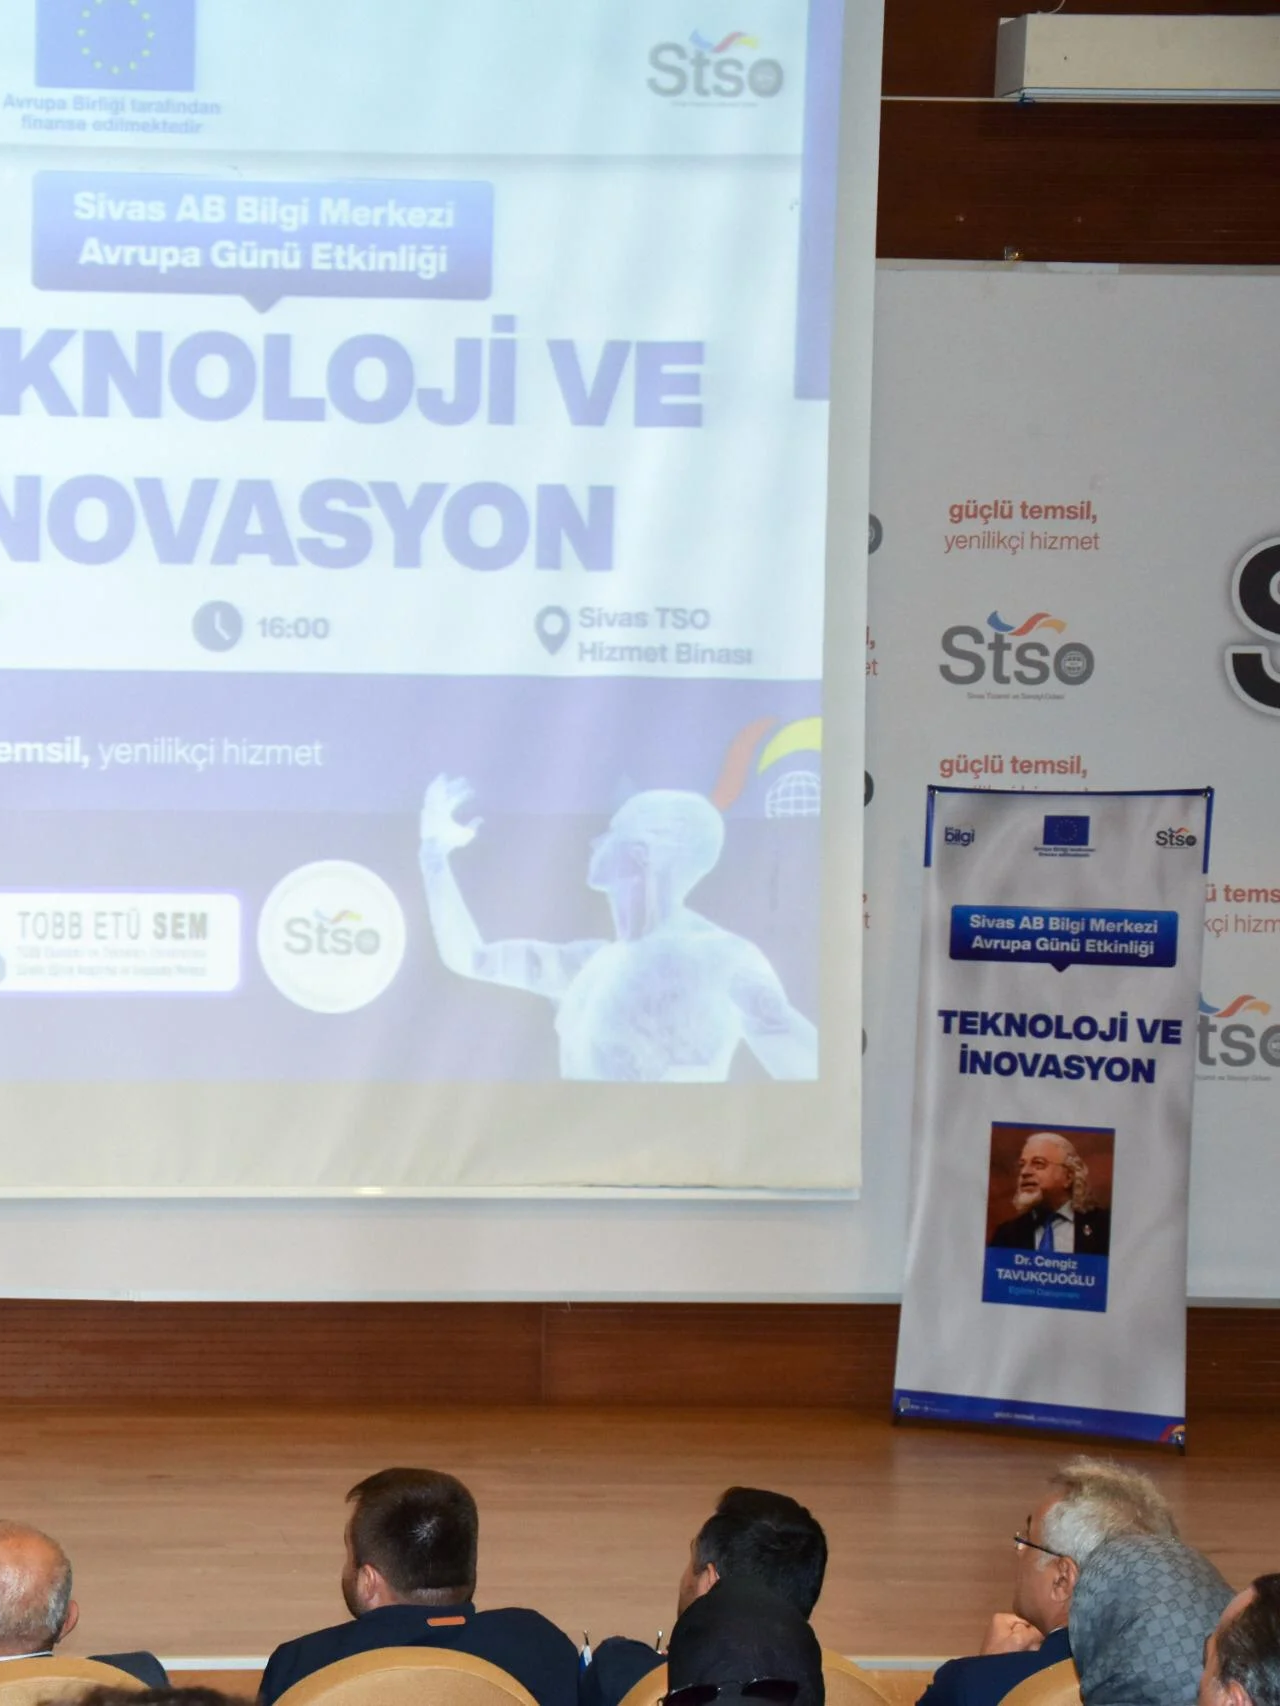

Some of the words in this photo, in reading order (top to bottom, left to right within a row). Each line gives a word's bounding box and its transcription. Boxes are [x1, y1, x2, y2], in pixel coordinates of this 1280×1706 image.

[3, 93, 67, 112] Avrupa
[22, 115, 86, 130] finanse
[92, 117, 203, 133] edilmektedir
[73, 191, 169, 226] Sivas
[176, 194, 227, 224] AB
[236, 195, 309, 232] Bilgi
[320, 197, 455, 230] Merkezi
[78, 237, 202, 274] Avrupa
[211, 238, 302, 271] Günü
[311, 242, 448, 279] Etkinliği
[548, 340, 706, 429] VE
[948, 500, 1014, 525] güçlü
[1020, 501, 1098, 524] temsil,
[944, 531, 1025, 555] yenilikçi
[1030, 531, 1100, 551] hizmet
[257, 616, 330, 640] 16:00
[578, 606, 647, 630] Sivas
[654, 607, 711, 631] TSO
[578, 640, 668, 665] Hizmet
[675, 641, 753, 666] Binası
[939, 625, 1095, 686] Stso
[98, 737, 216, 772] yenilikçi
[223, 738, 323, 767] hizmet
[939, 755, 1004, 779] güçlü
[1010, 755, 1088, 778] temsil,
[1224, 884, 1280, 903] tems
[17, 910, 82, 941] TOBB
[94, 906, 140, 941] ETÜ
[152, 911, 208, 941] SEM
[970, 914, 1015, 929] Sivas
[1019, 915, 1044, 930] AB
[1048, 916, 1084, 934] Bilgi
[1089, 917, 1158, 934] Merkezi
[1234, 914, 1280, 933] hizm
[972, 935, 1031, 952] Avrupa
[1035, 937, 1080, 952] Günü
[1085, 939, 1154, 957] Etkinliği
[938, 1009, 1128, 1043] TEKNOLOJİ
[1137, 1018, 1183, 1045] VE
[959, 1043, 1156, 1084] İNOVASYON
[1014, 1254, 1032, 1266] Dr.
[1034, 1255, 1078, 1271] Cengiz
[996, 1268, 1096, 1287] TAVUKÇUOĞLU
